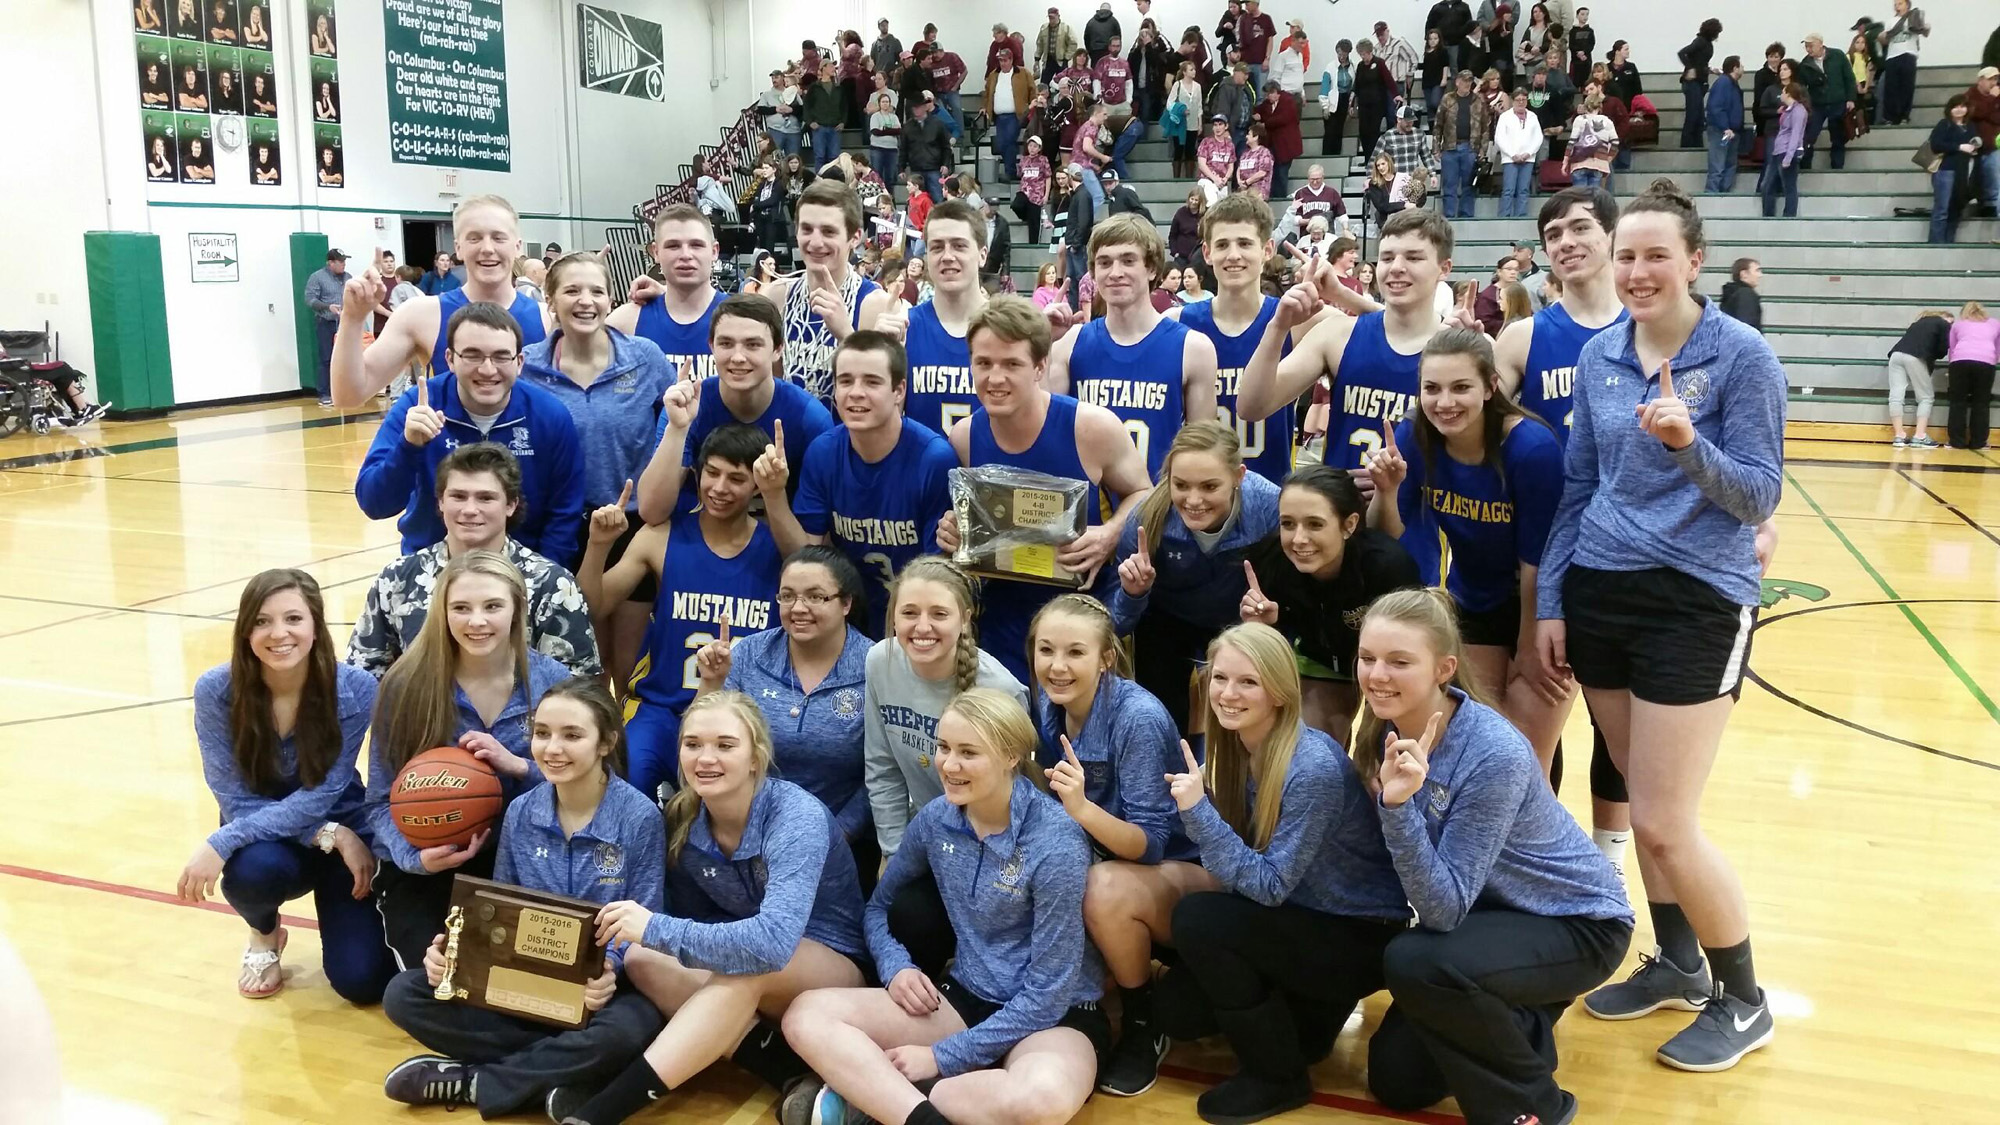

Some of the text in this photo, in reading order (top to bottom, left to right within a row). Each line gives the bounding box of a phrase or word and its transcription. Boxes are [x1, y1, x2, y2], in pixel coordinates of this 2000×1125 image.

[386, 0, 502, 32] Proud are we of all our glory
[398, 12, 488, 41] Here's our hail to thee
[420, 30, 476, 55] (rah-rah-rah)
[587, 19, 595, 75] COUGARS
[593, 20, 638, 77] ONWARD
[388, 50, 402, 65] On
[404, 52, 446, 72] Columbus
[452, 60, 466, 75] On
[467, 63, 505, 81] Columbus
[396, 67, 499, 95] Dear old white and green
[396, 80, 501, 109] Our hearts are in the fight
[405, 97, 496, 123] For VIC-TO-RY (HEY!)
[392, 121, 509, 148] C-O-U-G-A-R-S (rah-rah-rah)
[392, 138, 510, 164] C-O-U-G-A-R-S (rah-rah-rah)
[192, 235, 236, 247] HOSPITALITY
[200, 249, 222, 259] ROOM
[912, 365, 977, 395] MUSTA
[1077, 379, 1168, 410] MUSTANGS
[1021, 491, 1057, 502] 2015-2016
[1032, 501, 1045, 509] 4-B
[1021, 509, 1056, 518] DISTRICT
[832, 511, 919, 546] MUSTANGS
[672, 591, 771, 630] MUSTANGS
[880, 704, 941, 740] SHEPH
[398, 769, 470, 794] Baden
[401, 810, 463, 827] ELITE
[529, 913, 573, 929] 2015-2016
[541, 926, 556, 936] 4-B
[521, 944, 571, 961] CHAMPIONS
[526, 934, 568, 949] DISTRICT
